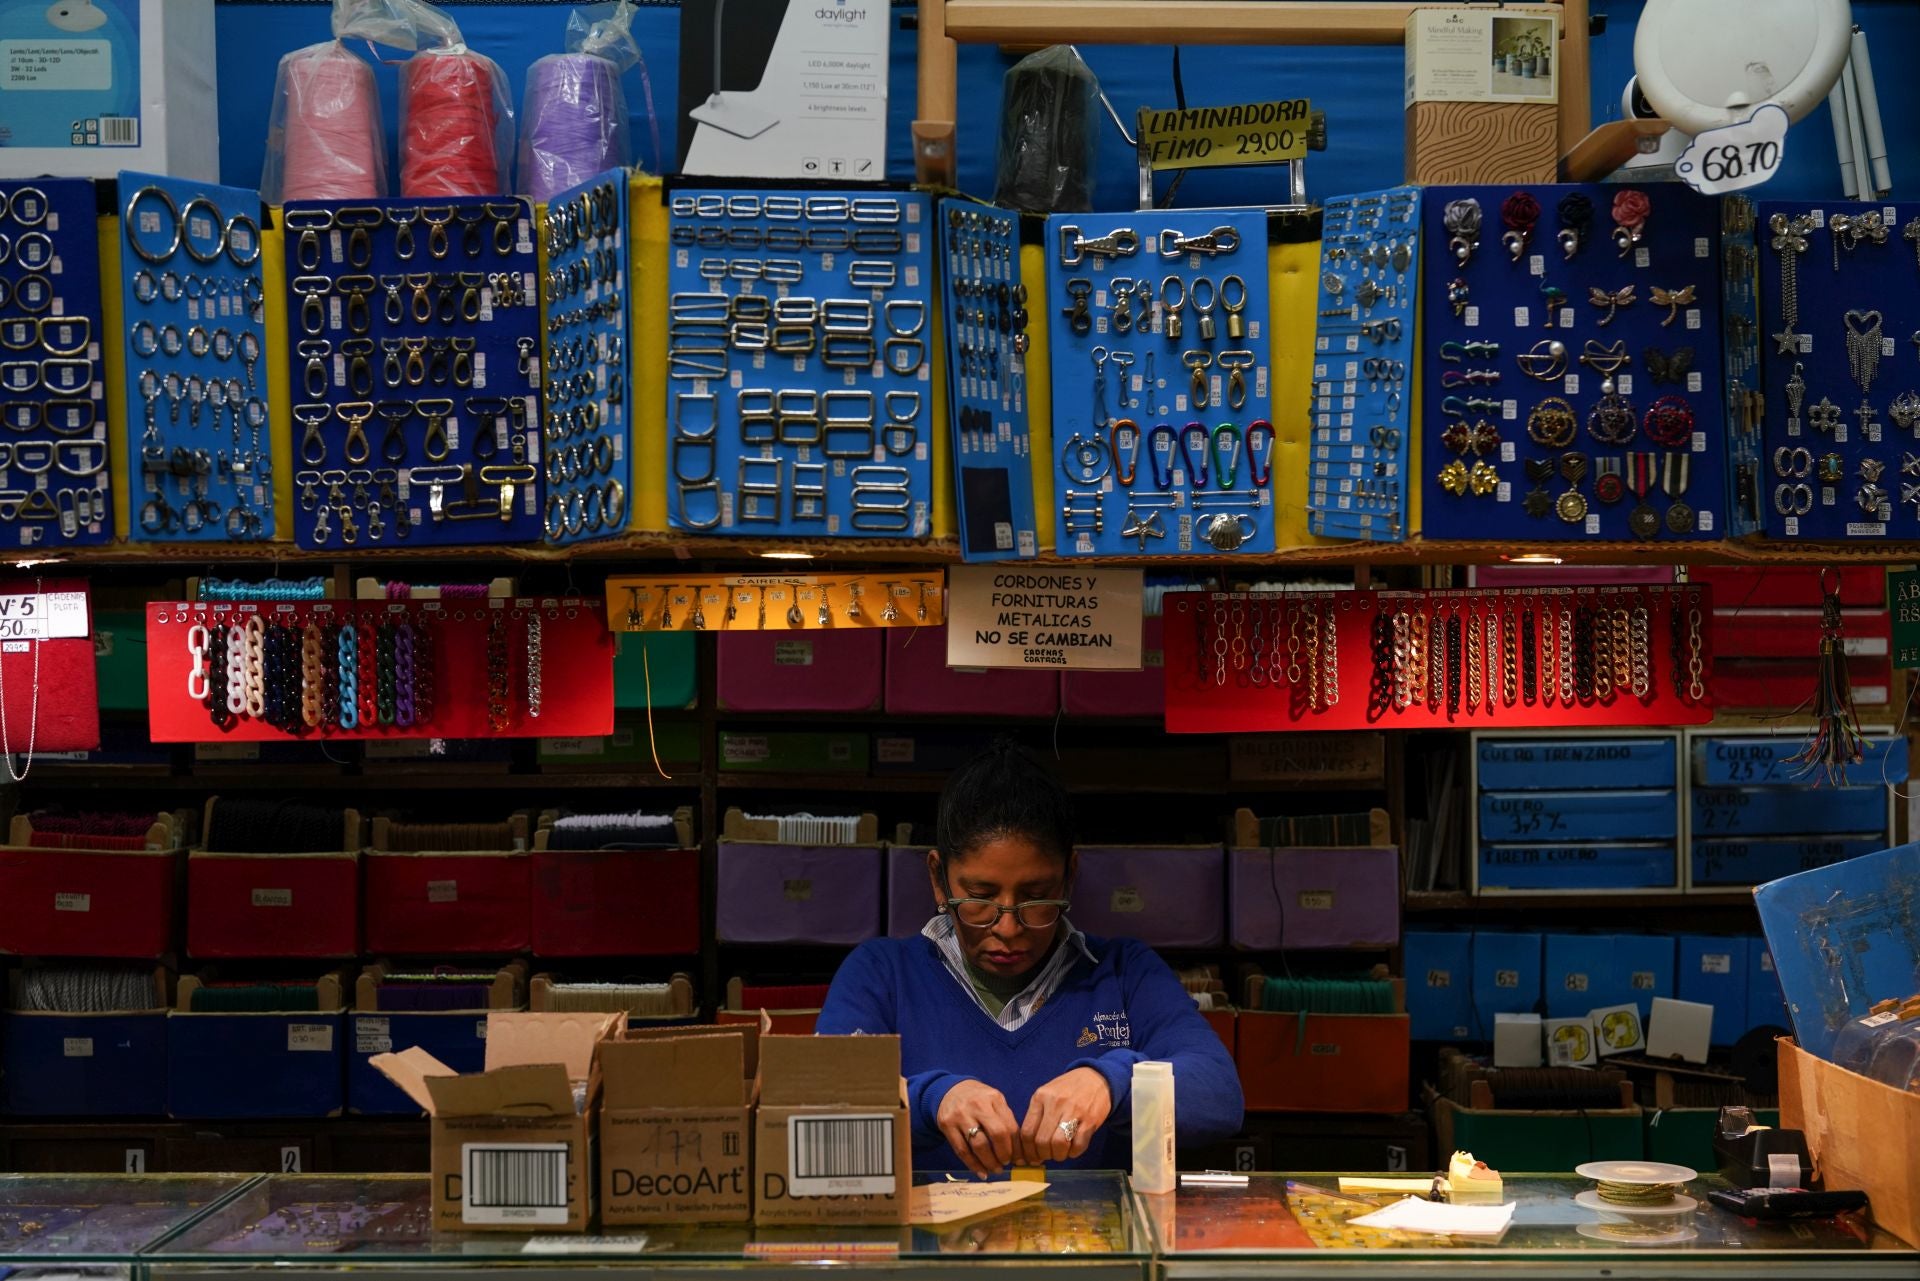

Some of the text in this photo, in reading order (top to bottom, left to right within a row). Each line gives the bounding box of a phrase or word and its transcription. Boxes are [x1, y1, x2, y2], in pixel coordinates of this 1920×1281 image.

[815, 8, 866, 23] daylight
[1427, 26, 1483, 36] Mindful Making
[808, 60, 822, 68] LED
[845, 62, 871, 71] daylight
[821, 82, 832, 90] Lux
[1151, 99, 1308, 134] LAMINADORA
[994, 574, 1097, 591] CORDONES Y
[48, 593, 85, 603] CADENAS
[992, 592, 1098, 609] FORNITURAS
[20, 596, 35, 617] 5
[54, 603, 79, 612] PLATA
[997, 612, 1091, 628] METALICAS
[975, 630, 1112, 648] NO SE CAMBIAN
[1023, 649, 1064, 657] CADENAS
[1024, 656, 1067, 665] CORTADAS
[1481, 746, 1630, 762] CUERO TRENZADO
[1716, 745, 1773, 761] CUERO
[1491, 801, 1544, 813] CUERO
[1697, 793, 1750, 807] CUERO
[1696, 844, 1749, 858] CUERO
[130, 1153, 138, 1174] 1
[285, 1150, 298, 1174] 2
[1238, 1150, 1254, 1173] 8
[609, 1205, 635, 1214] Acrylic
[675, 1204, 710, 1213] Specialty
[711, 1203, 747, 1211] Products
[760, 1209, 785, 1219] Acrylic
[788, 1209, 812, 1217] Paints
[827, 1209, 861, 1218] Specialty
[863, 1208, 898, 1217] Products
